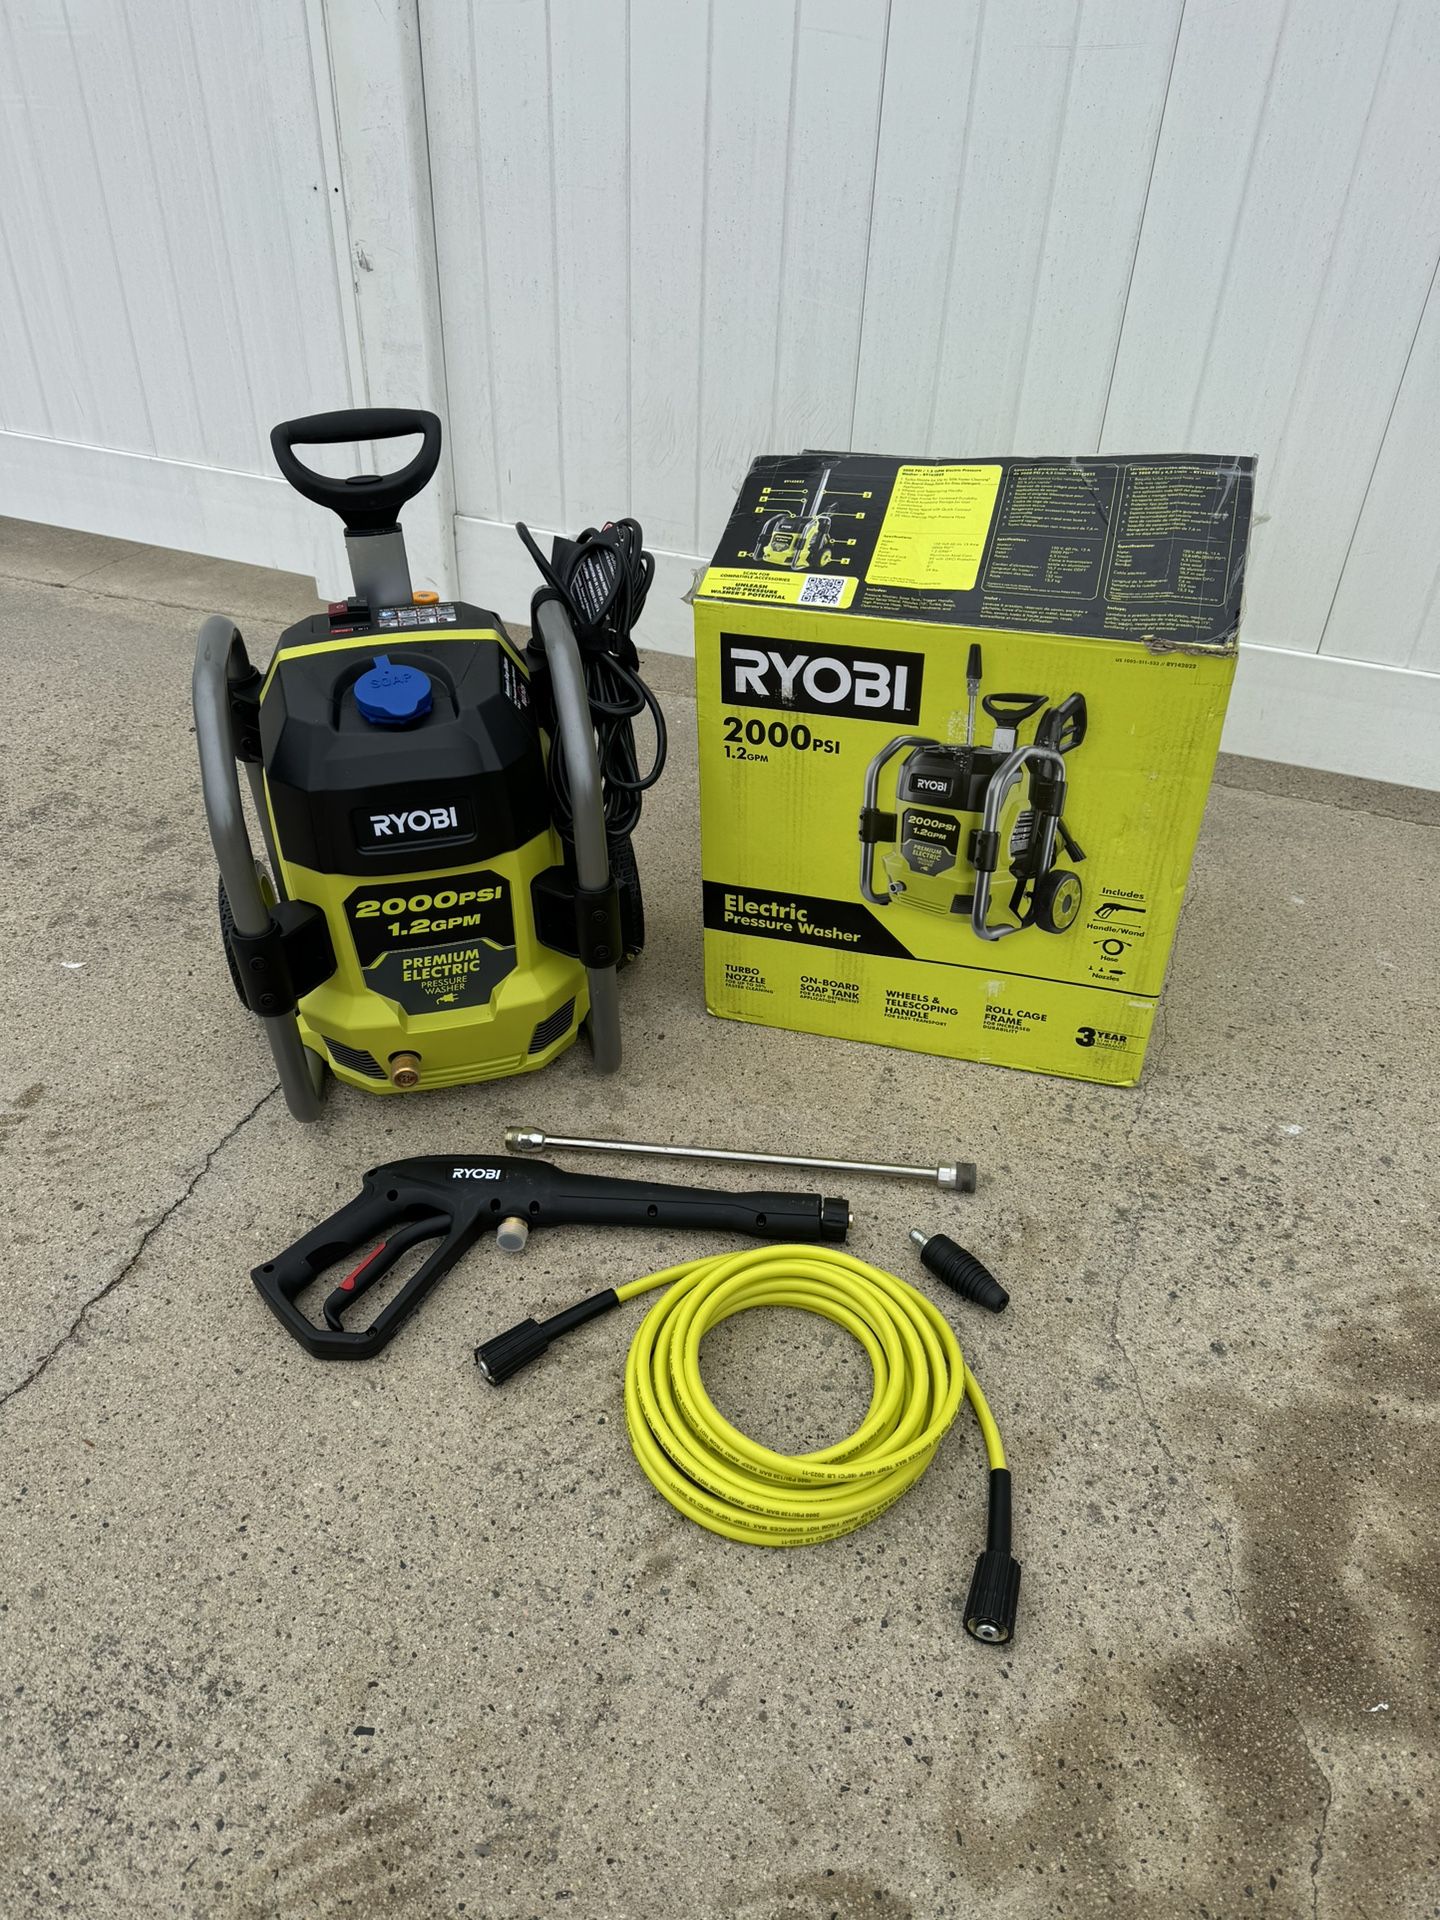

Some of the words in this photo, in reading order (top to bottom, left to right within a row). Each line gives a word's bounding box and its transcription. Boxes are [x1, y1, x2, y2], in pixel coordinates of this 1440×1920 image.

[748, 592, 786, 600] POTENTIAL
[370, 673, 411, 689] SOAP
[730, 648, 908, 711] RYOBI
[723, 716, 840, 754] 2000PSI
[724, 745, 769, 762] 1.2GPM
[917, 778, 947, 792] RYOBI
[370, 806, 458, 837] RYOBI
[908, 815, 956, 832] 2000PSI
[912, 827, 947, 840] 1.2GPM
[912, 850, 942, 861] ELECTRIC
[1102, 888, 1144, 900] Includes
[355, 886, 502, 918] 2000PSI
[724, 893, 808, 922] Electric
[388, 914, 482, 936] 1.2GPM
[724, 911, 793, 932] Pressure
[798, 922, 861, 942] Washer
[1086, 923, 1145, 937] Handle/Wand
[403, 948, 480, 970] PREMIUM
[1100, 954, 1119, 962] Hose
[403, 960, 480, 982] ELECTRIC
[725, 964, 760, 975] TURBO
[421, 975, 468, 989] PRESSURE
[726, 972, 766, 984] NOZZLE
[800, 975, 860, 992] ON-BOARD
[1092, 972, 1120, 982] Nozzles
[425, 983, 466, 995] WASHER
[800, 984, 828, 995] SOAP
[830, 988, 860, 1000] TANK
[886, 990, 929, 1002] WHEELS
[932, 996, 940, 1004] &
[884, 1006, 929, 1020] HANDLE
[886, 998, 958, 1016] TELESCOPING
[985, 1004, 1013, 1016] ROLL
[1016, 1010, 1047, 1022] CAGE
[912, 1017, 947, 1027] TRANSPORT
[984, 1013, 1022, 1026] FRAME
[982, 1024, 1018, 1034] DURABILITY
[1076, 1026, 1096, 1048] 3
[1097, 1031, 1127, 1043] YEAR
[452, 1168, 501, 1180] RYOBI
[724, 1450, 739, 1464] AWAY
[741, 1462, 758, 1472] KEEP
[698, 1476, 709, 1487] HOT
[710, 1486, 726, 1498] FROM
[728, 1496, 744, 1506] AWAY
[747, 1504, 764, 1513] KEEP
[734, 1519, 750, 1528] TEMP
[822, 1522, 840, 1530] FROM
